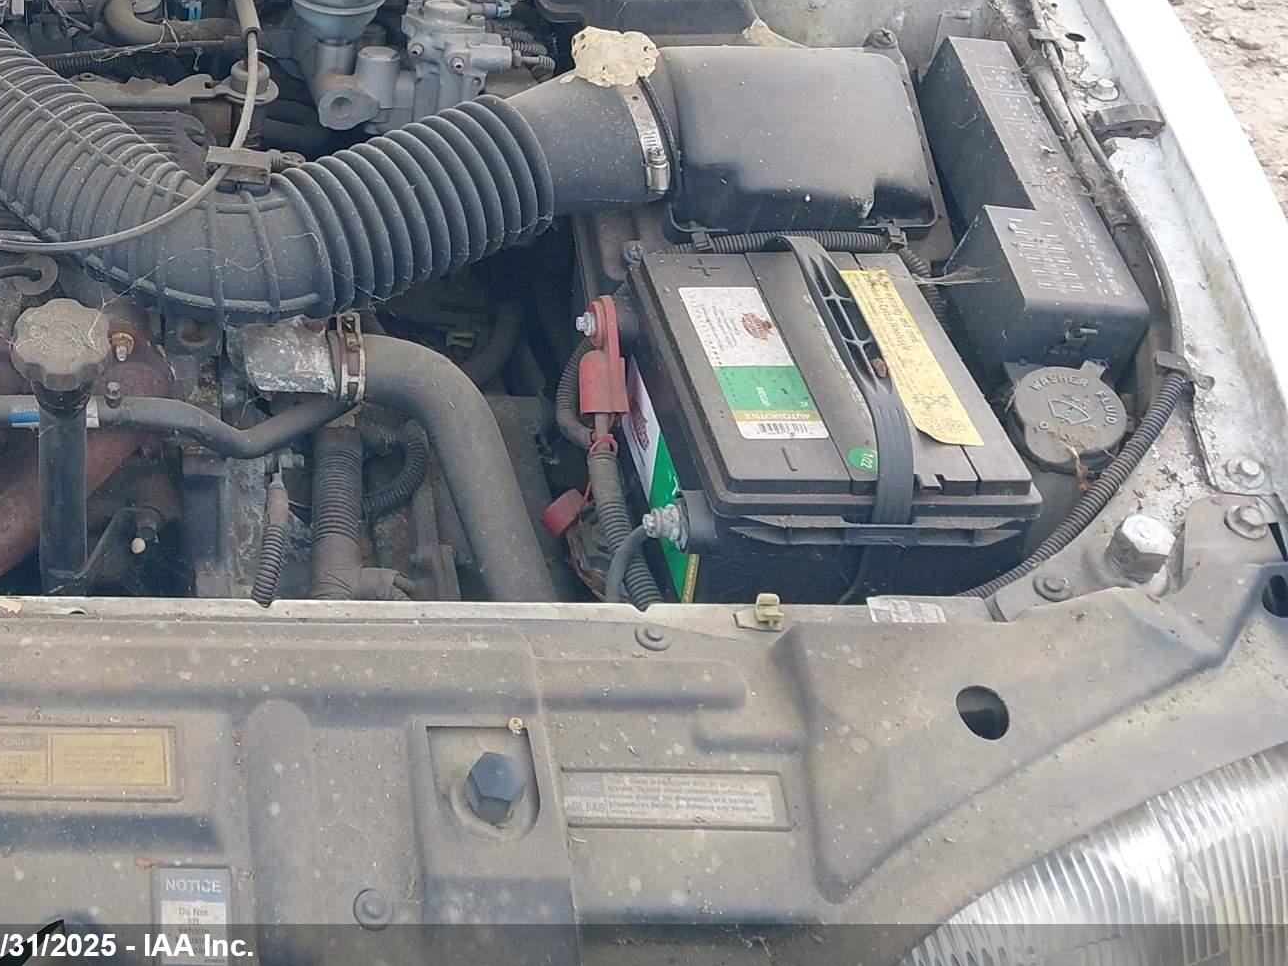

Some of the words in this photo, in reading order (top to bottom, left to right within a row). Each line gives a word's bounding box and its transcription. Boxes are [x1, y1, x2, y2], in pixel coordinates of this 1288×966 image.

[1030, 374, 1089, 392] WASHER
[1095, 389, 1119, 425] FLUID
[165, 878, 222, 893] NOTICE
[178, 907, 191, 916] Do
[192, 907, 209, 917] Not
